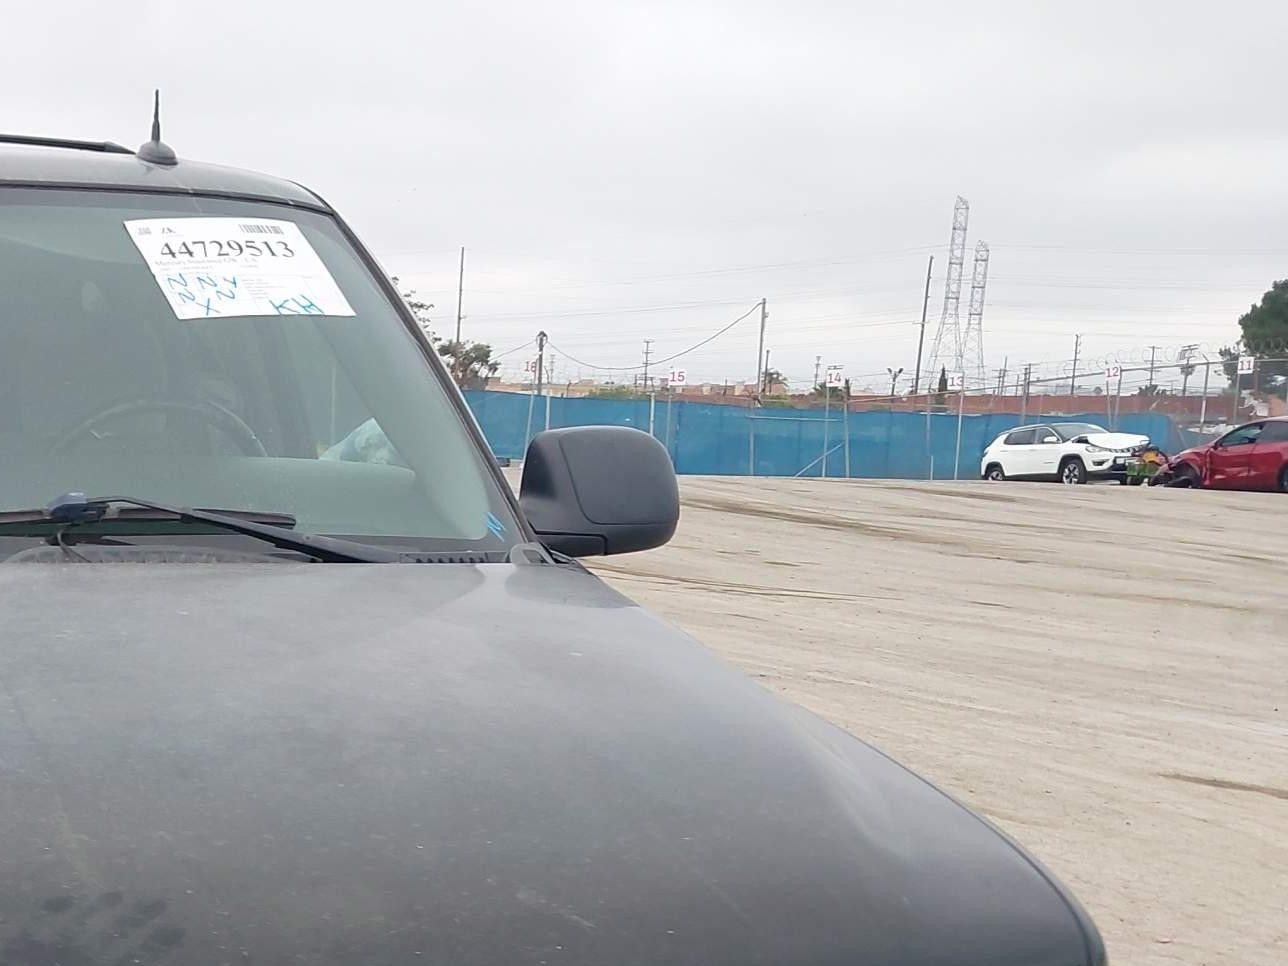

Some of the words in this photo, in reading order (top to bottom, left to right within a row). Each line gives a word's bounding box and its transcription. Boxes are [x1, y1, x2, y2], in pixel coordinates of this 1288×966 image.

[160, 240, 295, 258] 44729513
[670, 371, 685, 382] 15
[1106, 366, 1119, 377] 12
[828, 373, 841, 384] 14
[950, 376, 963, 386] 13
